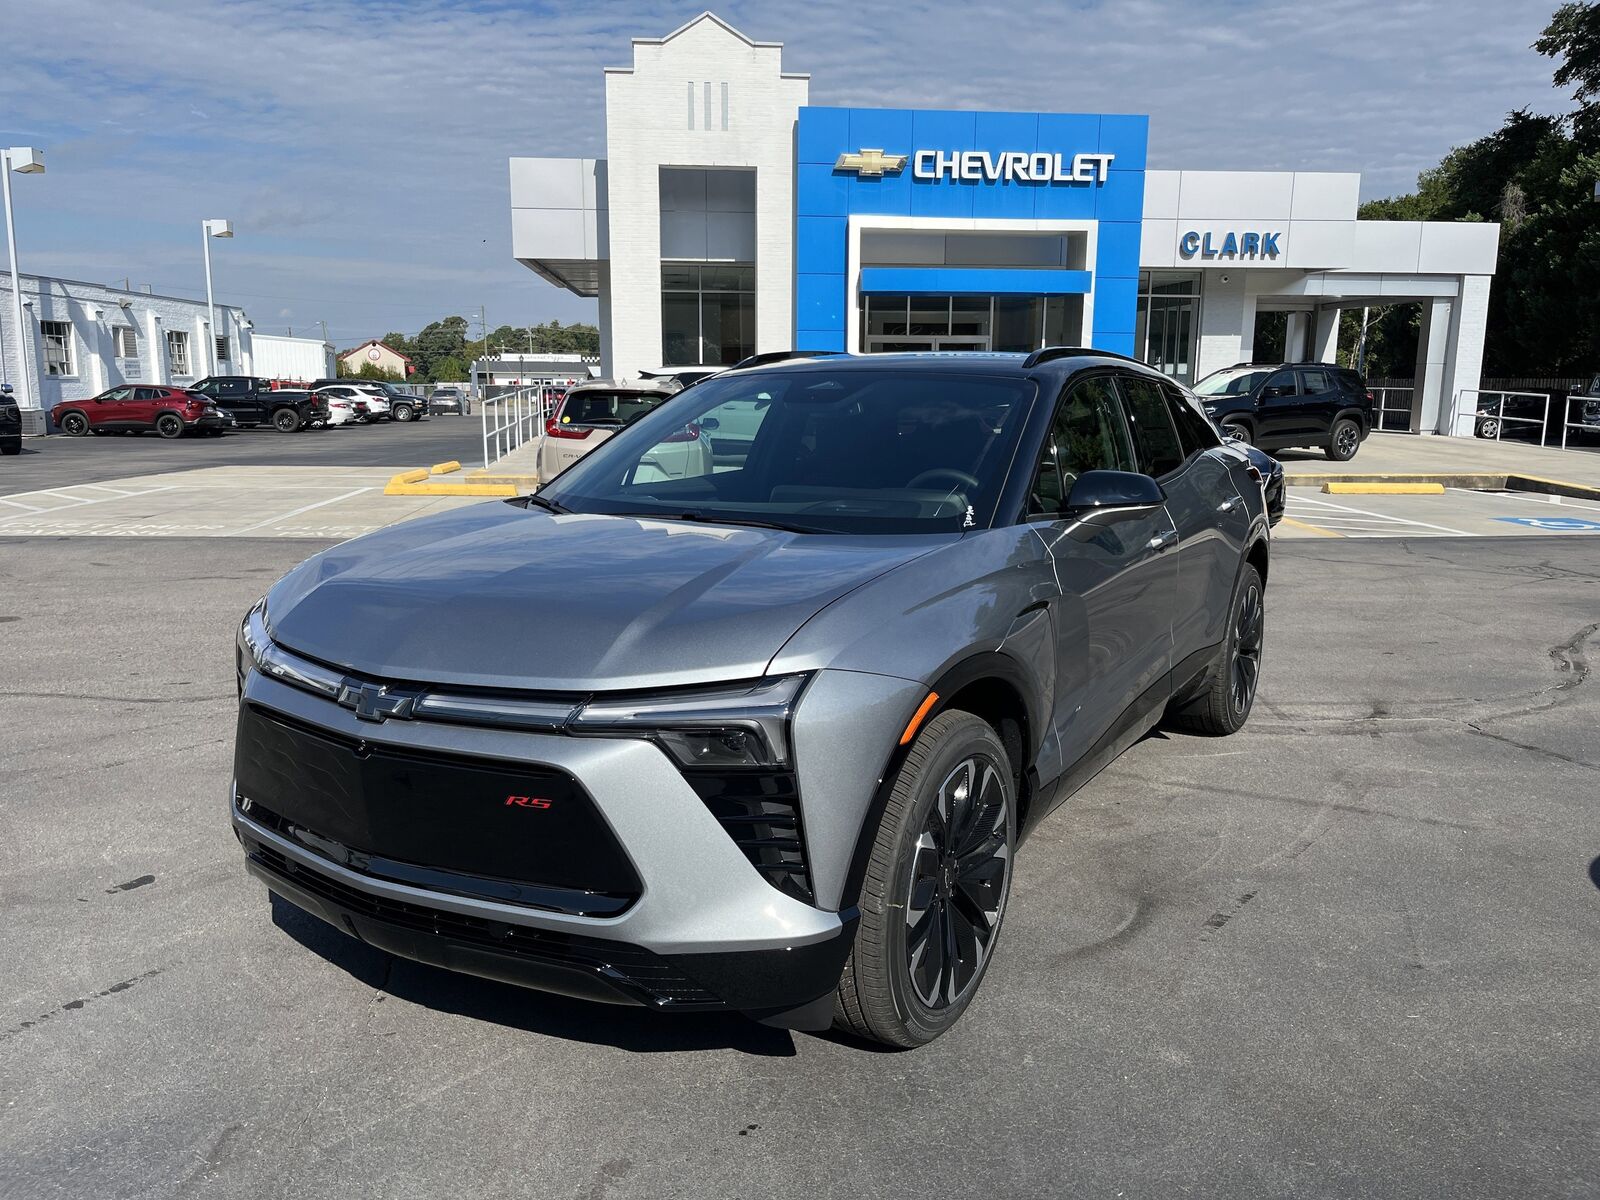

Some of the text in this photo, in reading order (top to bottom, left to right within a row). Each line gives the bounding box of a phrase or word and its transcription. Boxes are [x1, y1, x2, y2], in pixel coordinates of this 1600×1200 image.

[914, 149, 1116, 183] CHEVROLET
[1181, 231, 1281, 257] CLARK
[505, 796, 552, 809] RS
